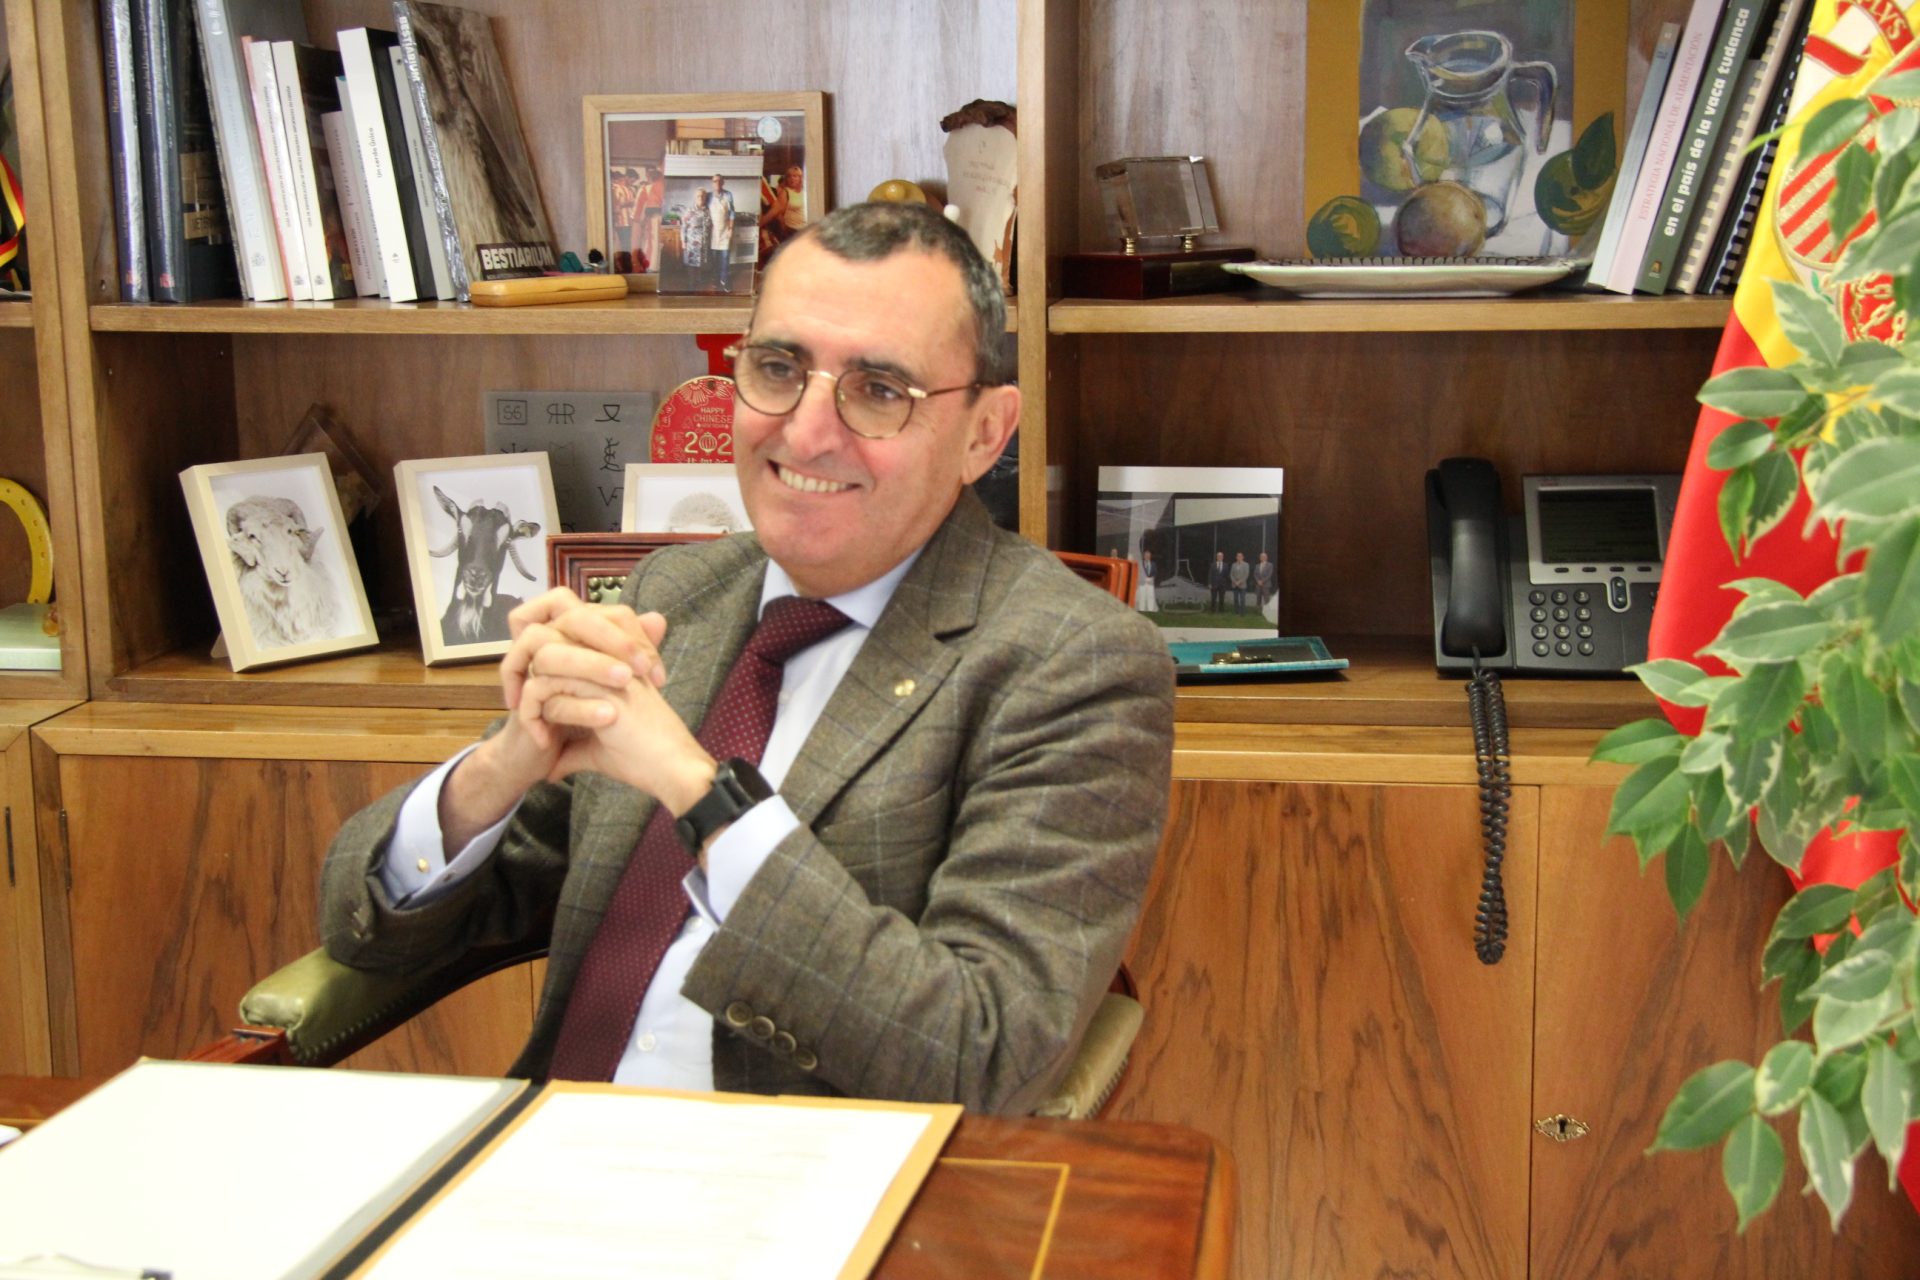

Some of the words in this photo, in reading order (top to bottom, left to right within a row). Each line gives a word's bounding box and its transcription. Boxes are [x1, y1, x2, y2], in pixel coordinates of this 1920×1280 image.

[1857, 0, 1906, 39] LVS
[1717, 8, 1750, 74] tudanca
[1704, 78, 1726, 115] vaca
[1696, 119, 1712, 135] la
[1689, 139, 1706, 158] de
[1671, 198, 1686, 213] el
[1664, 216, 1679, 237] en
[480, 246, 556, 270] BESTIARIUM
[693, 414, 734, 424] CHINESE
